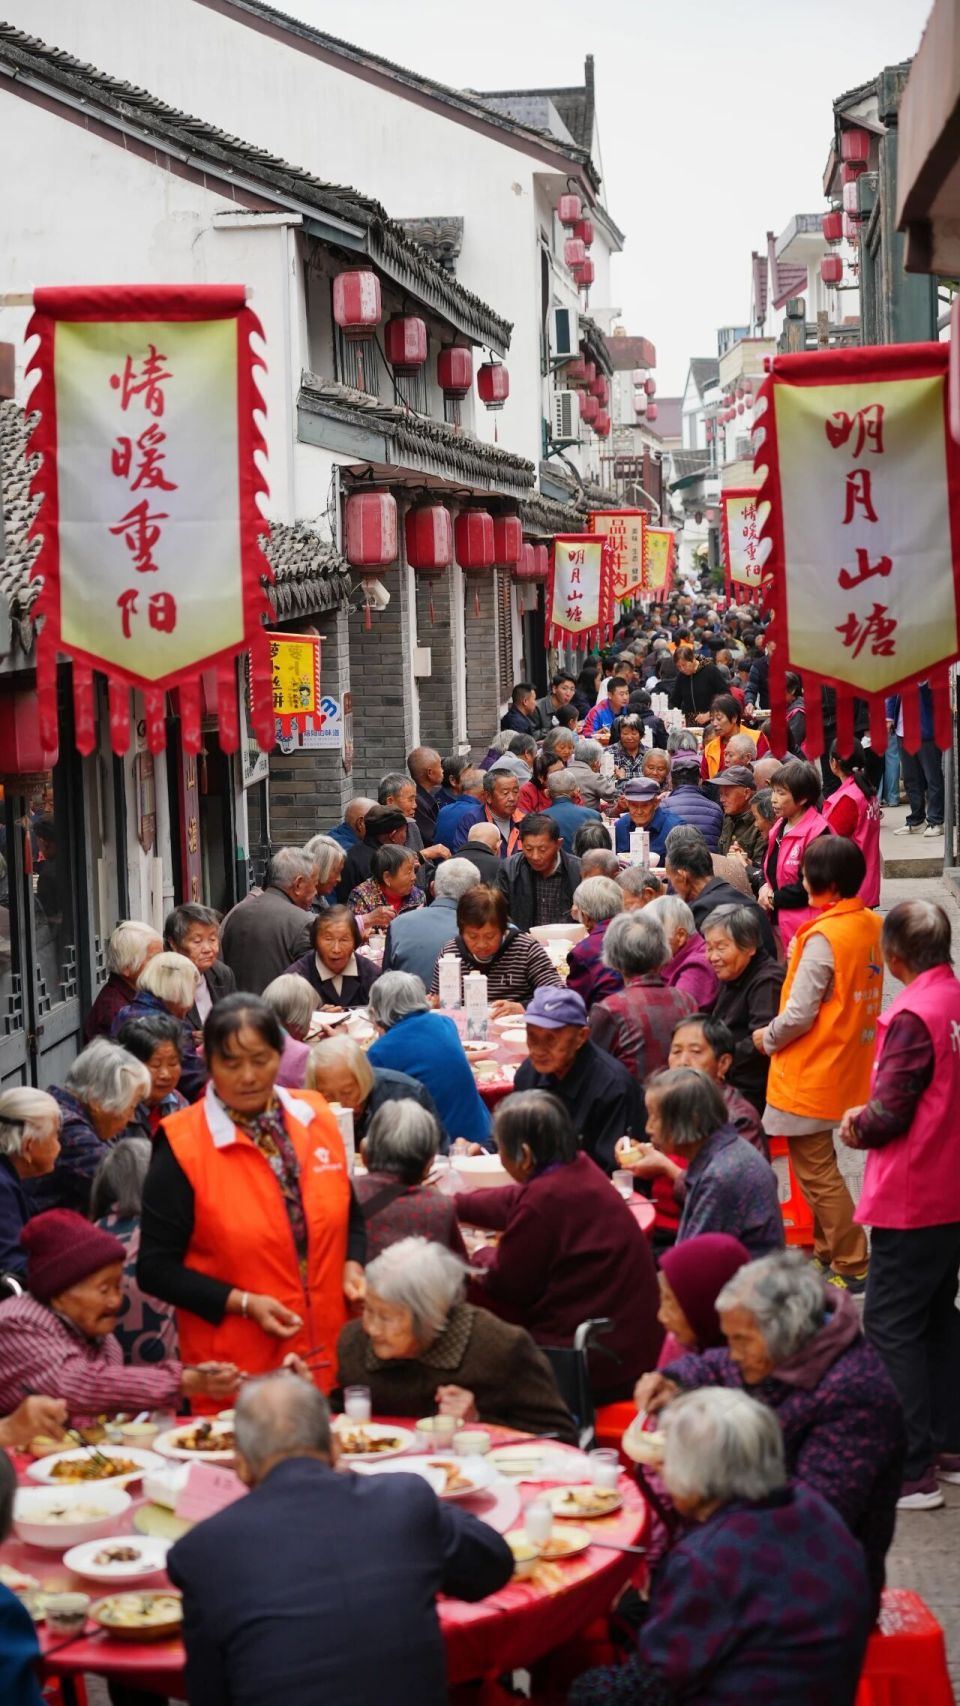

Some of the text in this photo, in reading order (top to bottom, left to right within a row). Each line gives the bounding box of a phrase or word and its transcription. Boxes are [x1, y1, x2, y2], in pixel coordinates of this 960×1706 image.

[110, 344, 178, 639] 情暖重阳
[609, 519, 629, 588] 品味牛肉
[741, 503, 761, 577] 情暖重阳
[825, 404, 897, 659] 明月山塘
[566, 549, 585, 622] 明月山塘
